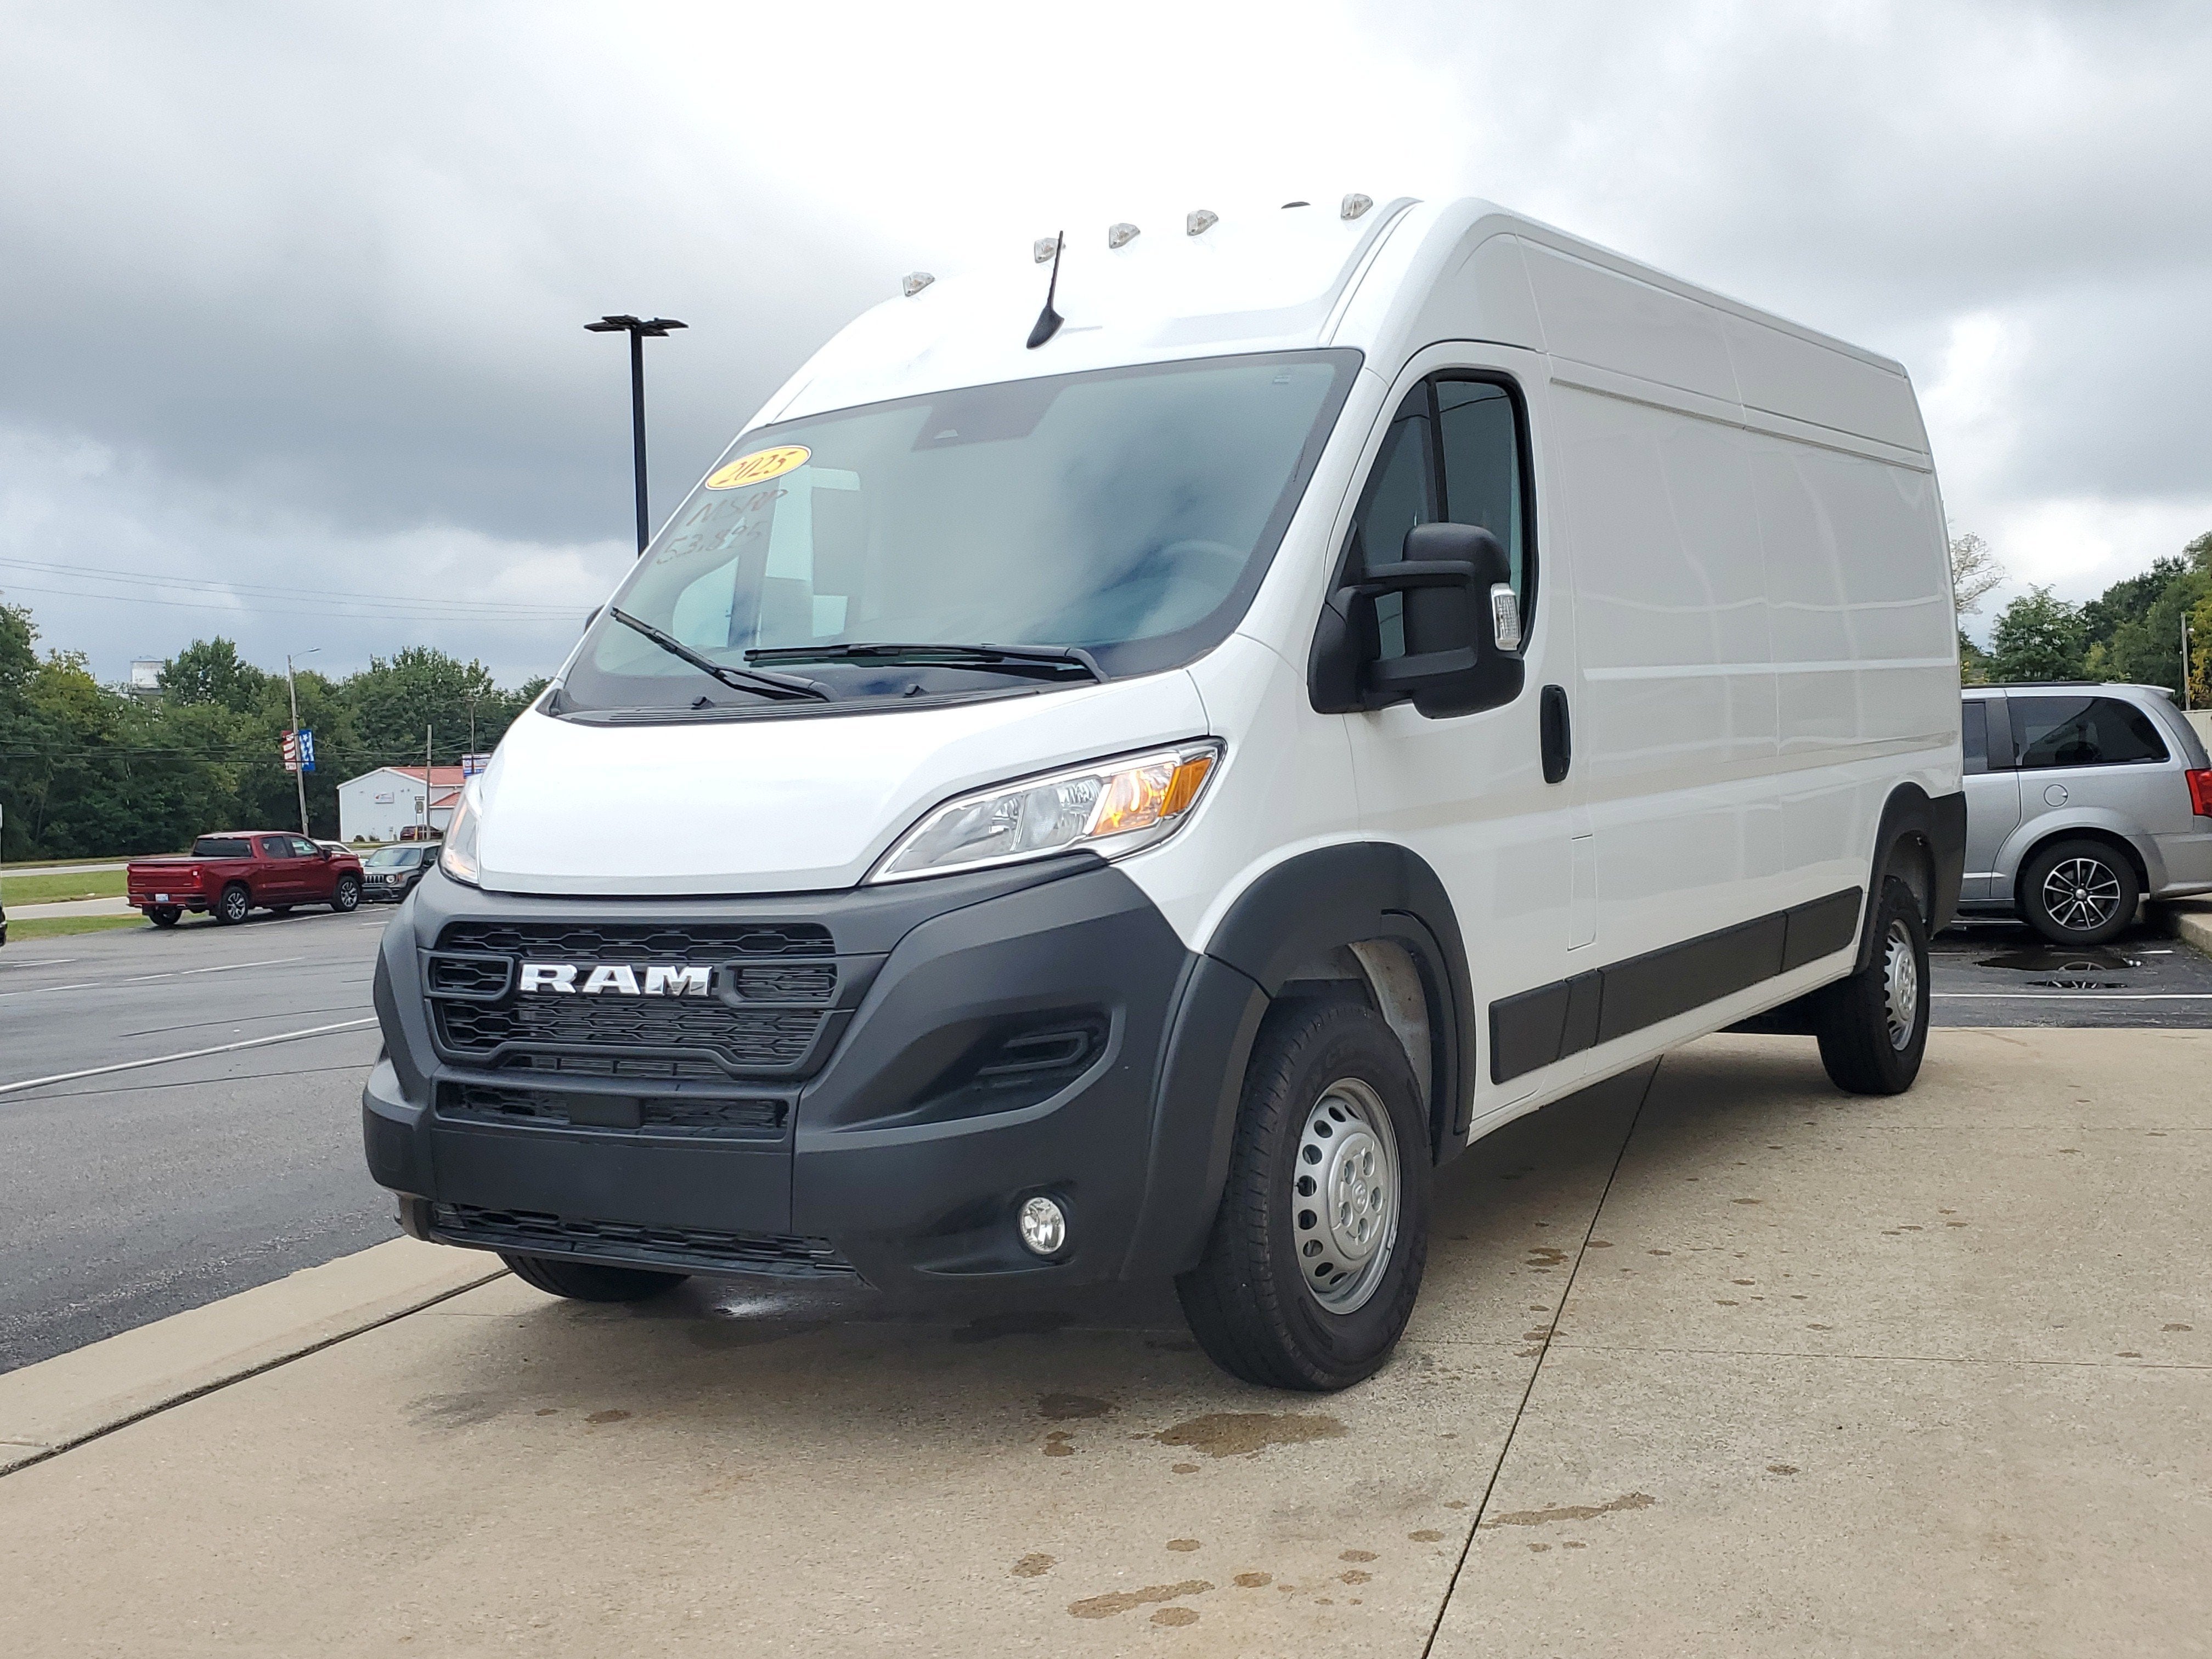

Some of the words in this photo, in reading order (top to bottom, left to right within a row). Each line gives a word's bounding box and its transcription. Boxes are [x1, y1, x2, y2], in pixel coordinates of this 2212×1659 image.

[715, 451, 799, 485] 2025
[686, 489, 788, 526] MSRP
[520, 964, 713, 997] RAM
